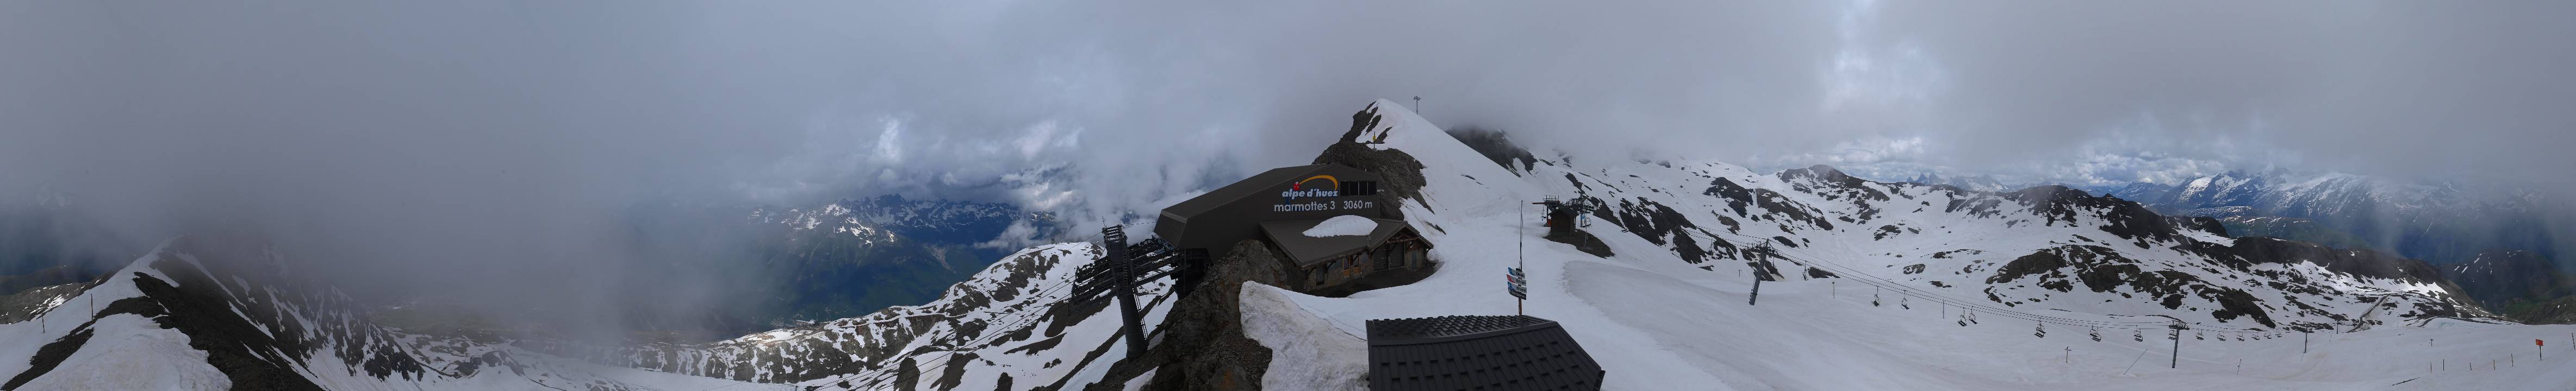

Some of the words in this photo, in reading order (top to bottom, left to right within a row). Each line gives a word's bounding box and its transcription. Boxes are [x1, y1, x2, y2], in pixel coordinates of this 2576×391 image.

[1282, 188, 1305, 199] alpe
[1274, 201, 1327, 212] marmottes
[1330, 200, 1335, 210] 3
[1343, 200, 1363, 210] 3060
